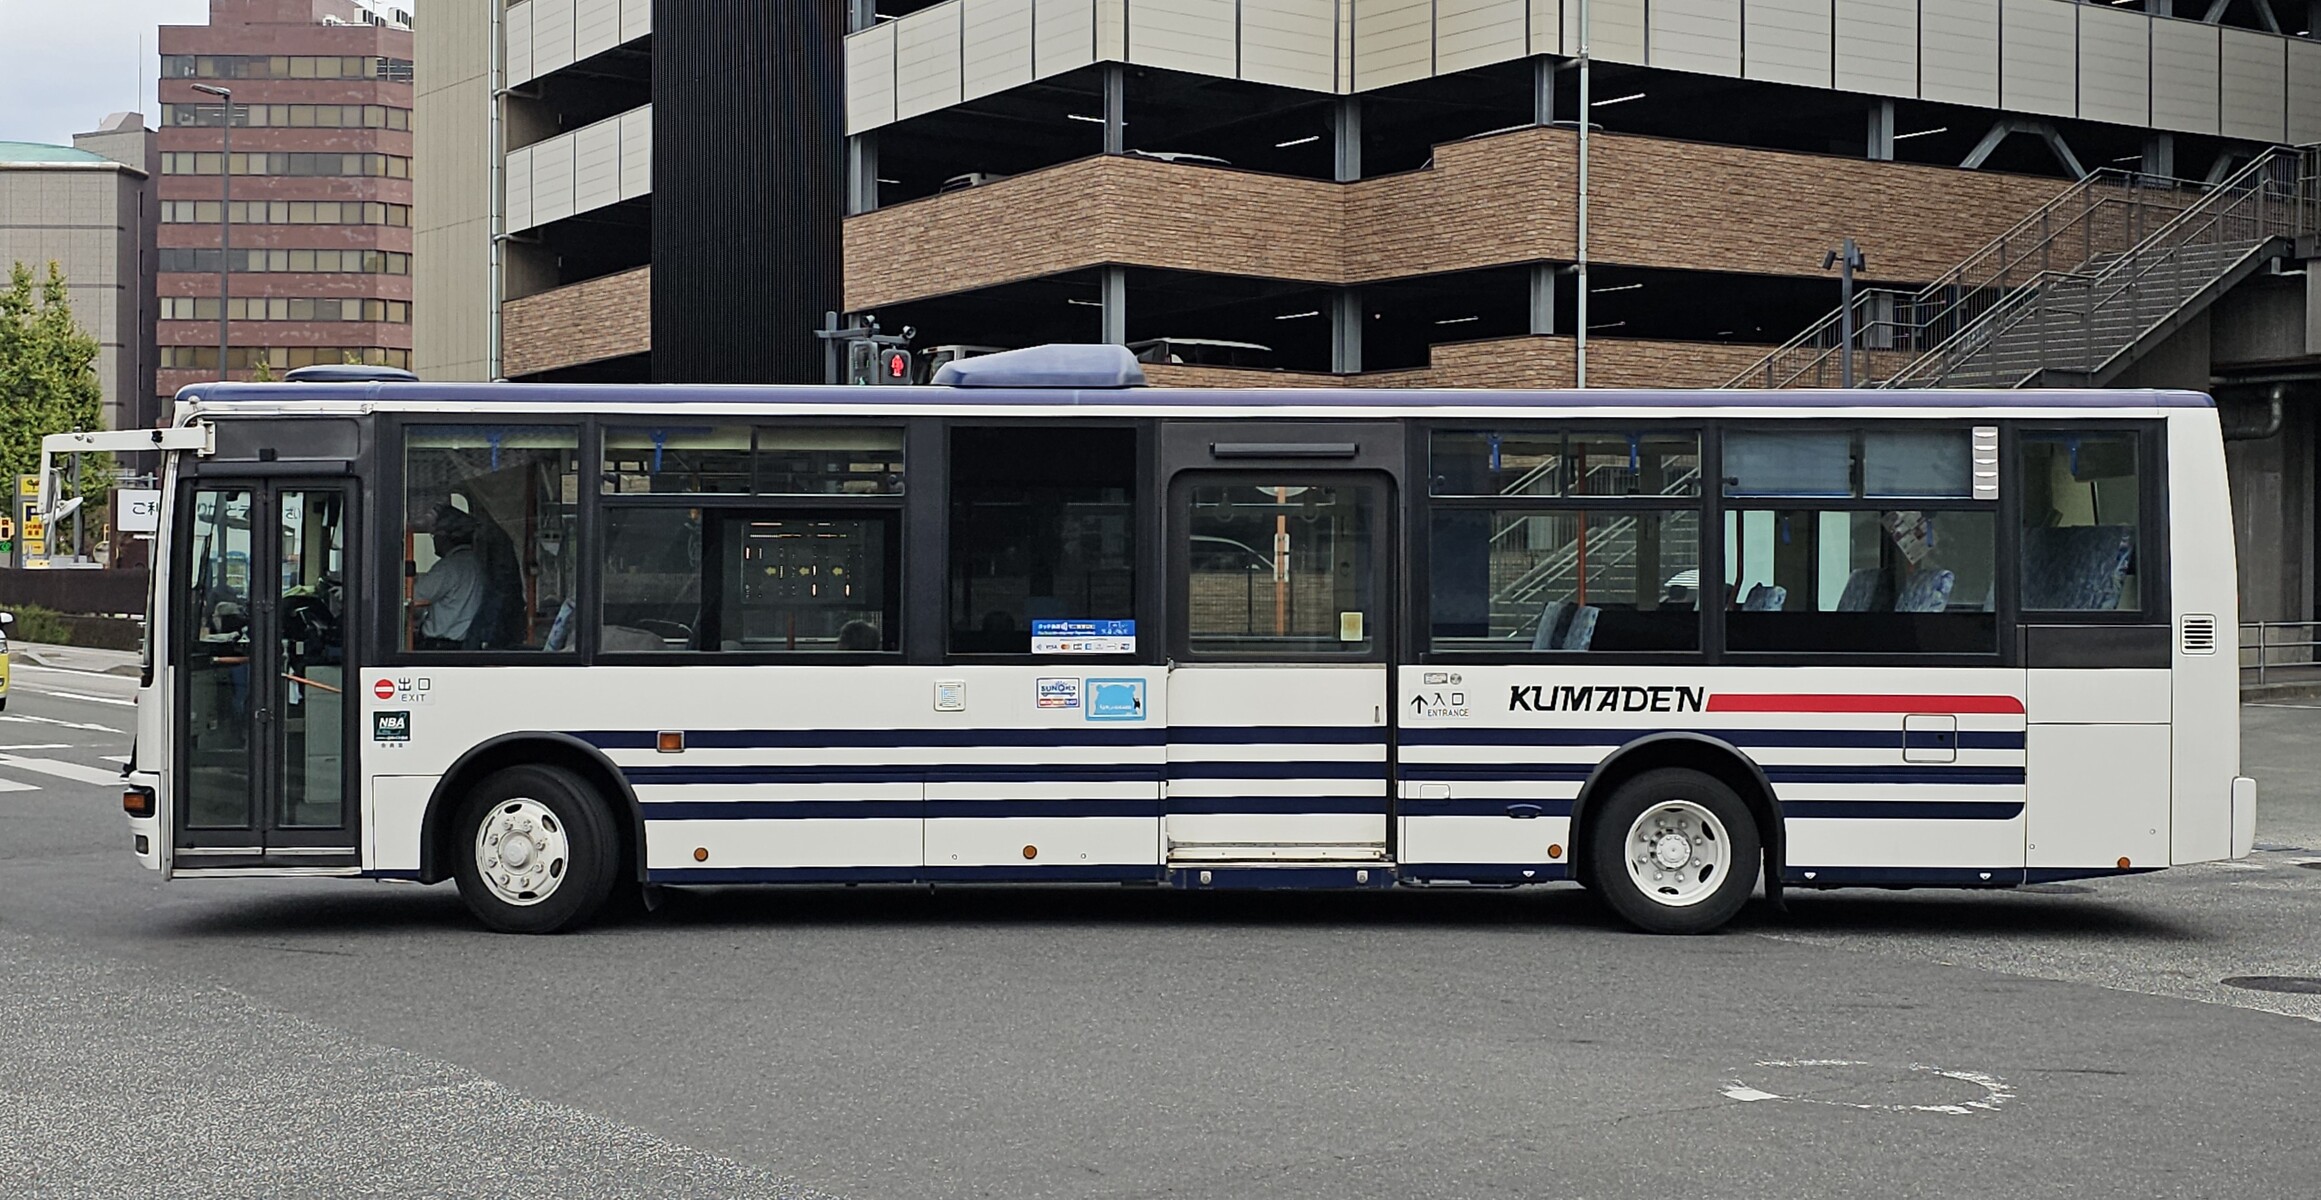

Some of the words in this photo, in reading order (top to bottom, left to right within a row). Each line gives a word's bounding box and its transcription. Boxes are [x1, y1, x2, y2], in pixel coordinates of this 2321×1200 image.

[398, 677, 430, 691] 出口
[401, 693, 426, 702] EXIT
[1433, 692, 1464, 706] 入口
[1509, 685, 1704, 712] KUMADEN
[1427, 709, 1469, 717] ENTRANCE
[380, 717, 405, 729] NBA
